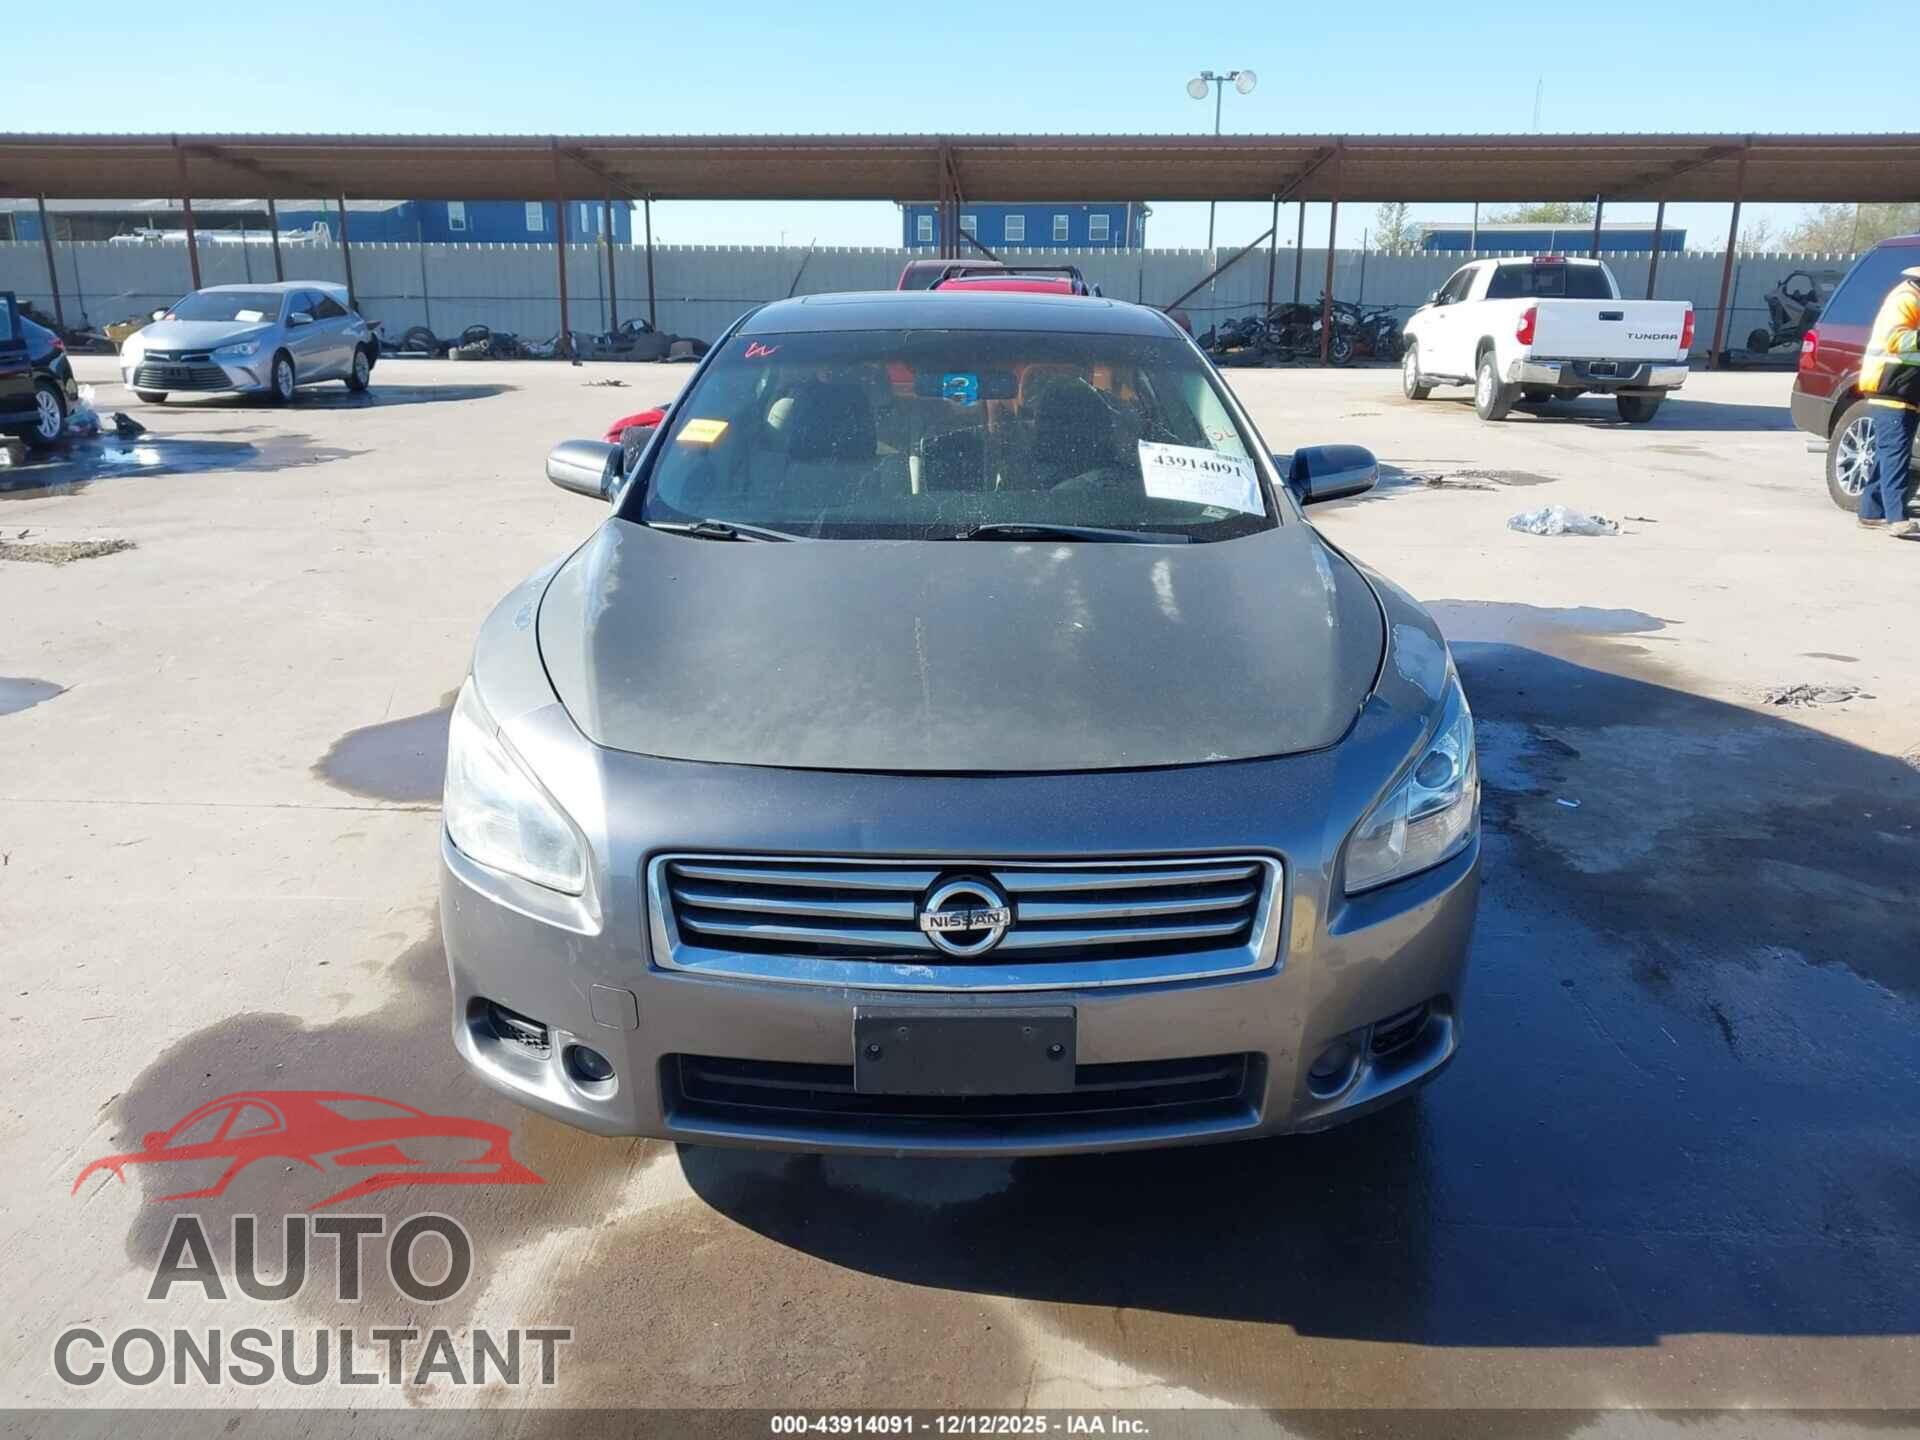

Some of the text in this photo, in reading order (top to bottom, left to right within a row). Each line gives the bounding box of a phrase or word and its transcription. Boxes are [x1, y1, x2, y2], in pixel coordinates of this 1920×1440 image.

[1627, 332, 1678, 341] TUNDRA
[1153, 455, 1241, 477] 43914091
[929, 910, 1001, 928] NISSAN
